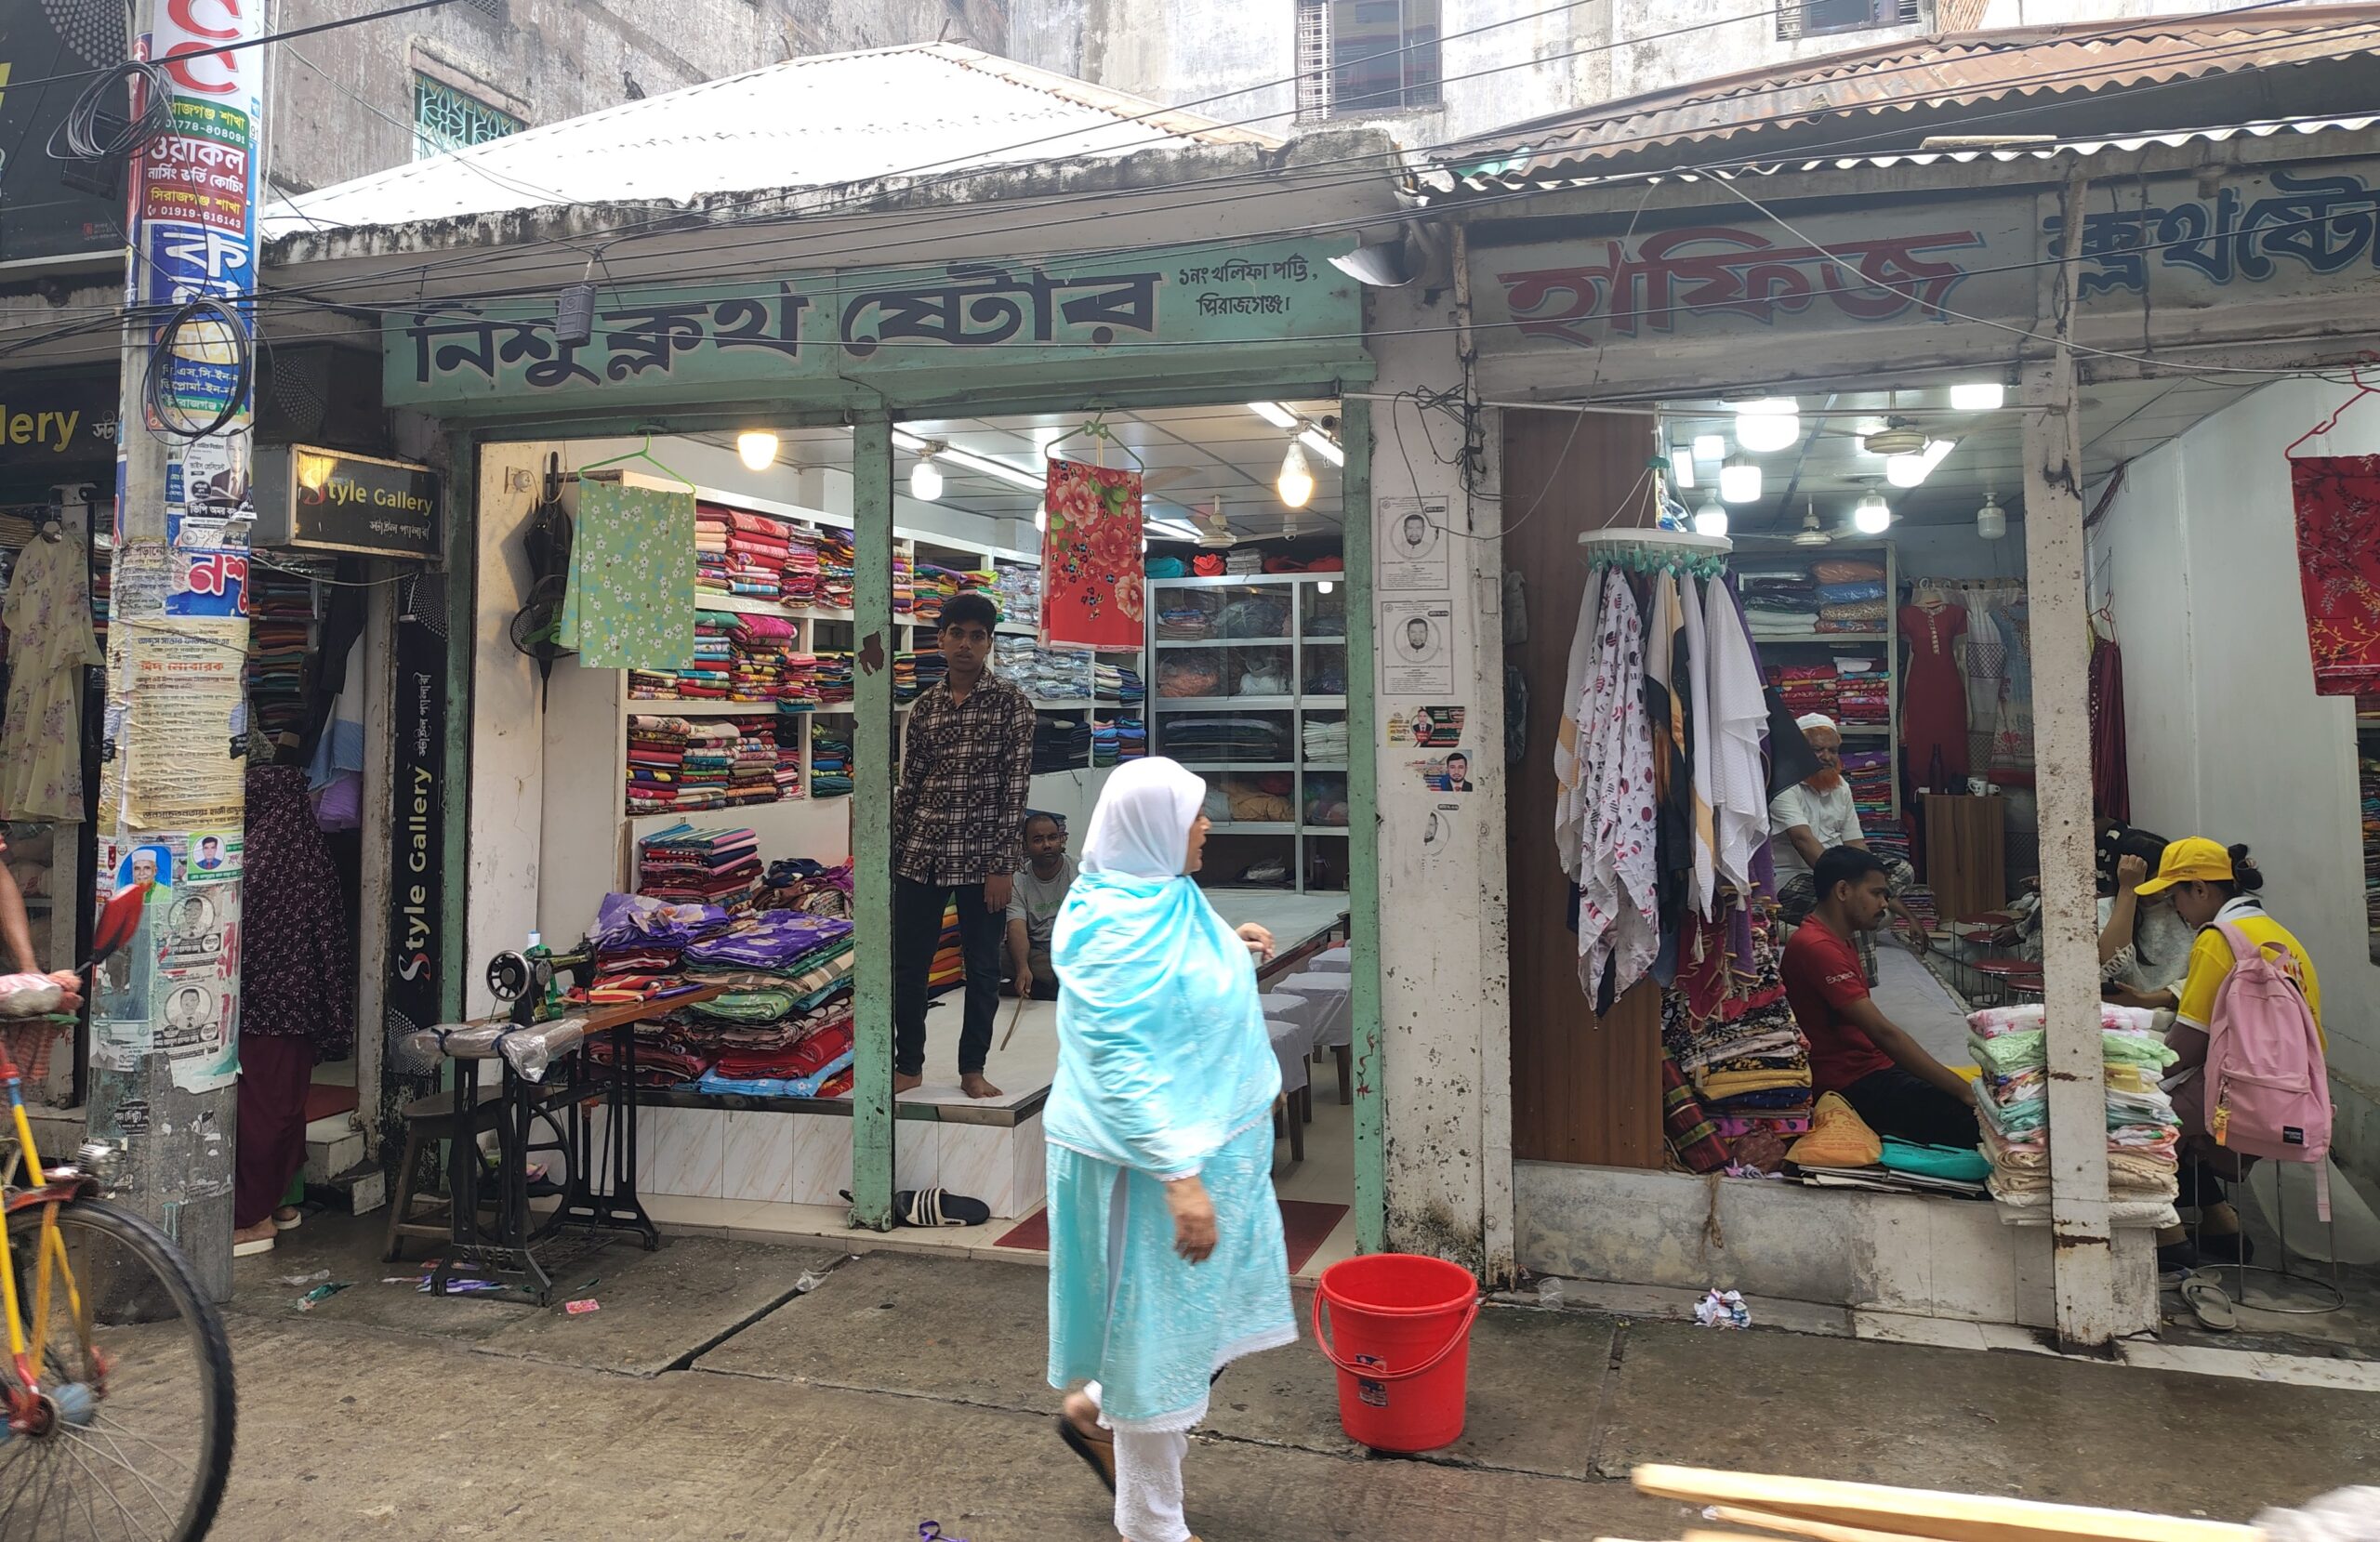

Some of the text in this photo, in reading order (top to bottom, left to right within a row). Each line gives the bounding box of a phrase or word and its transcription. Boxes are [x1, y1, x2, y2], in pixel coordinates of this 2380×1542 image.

[219, 110, 245, 130] শাখা
[151, 136, 245, 175] ওরাকল
[148, 163, 244, 194] নার্সিং ভর্তি কোচিং
[151, 187, 242, 215] সিরাজগঞ্জ শাখা
[161, 205, 242, 229] 01919-616143
[1179, 267, 1209, 285] ১নং
[1211, 257, 1271, 283] খলিফা
[1495, 225, 1986, 349] হাফিজ
[601, 281, 811, 381] ক্লথ
[840, 261, 1164, 358] ষ্টোর
[302, 468, 433, 516] Style Gallery
[398, 765, 432, 982] Style Gallery
